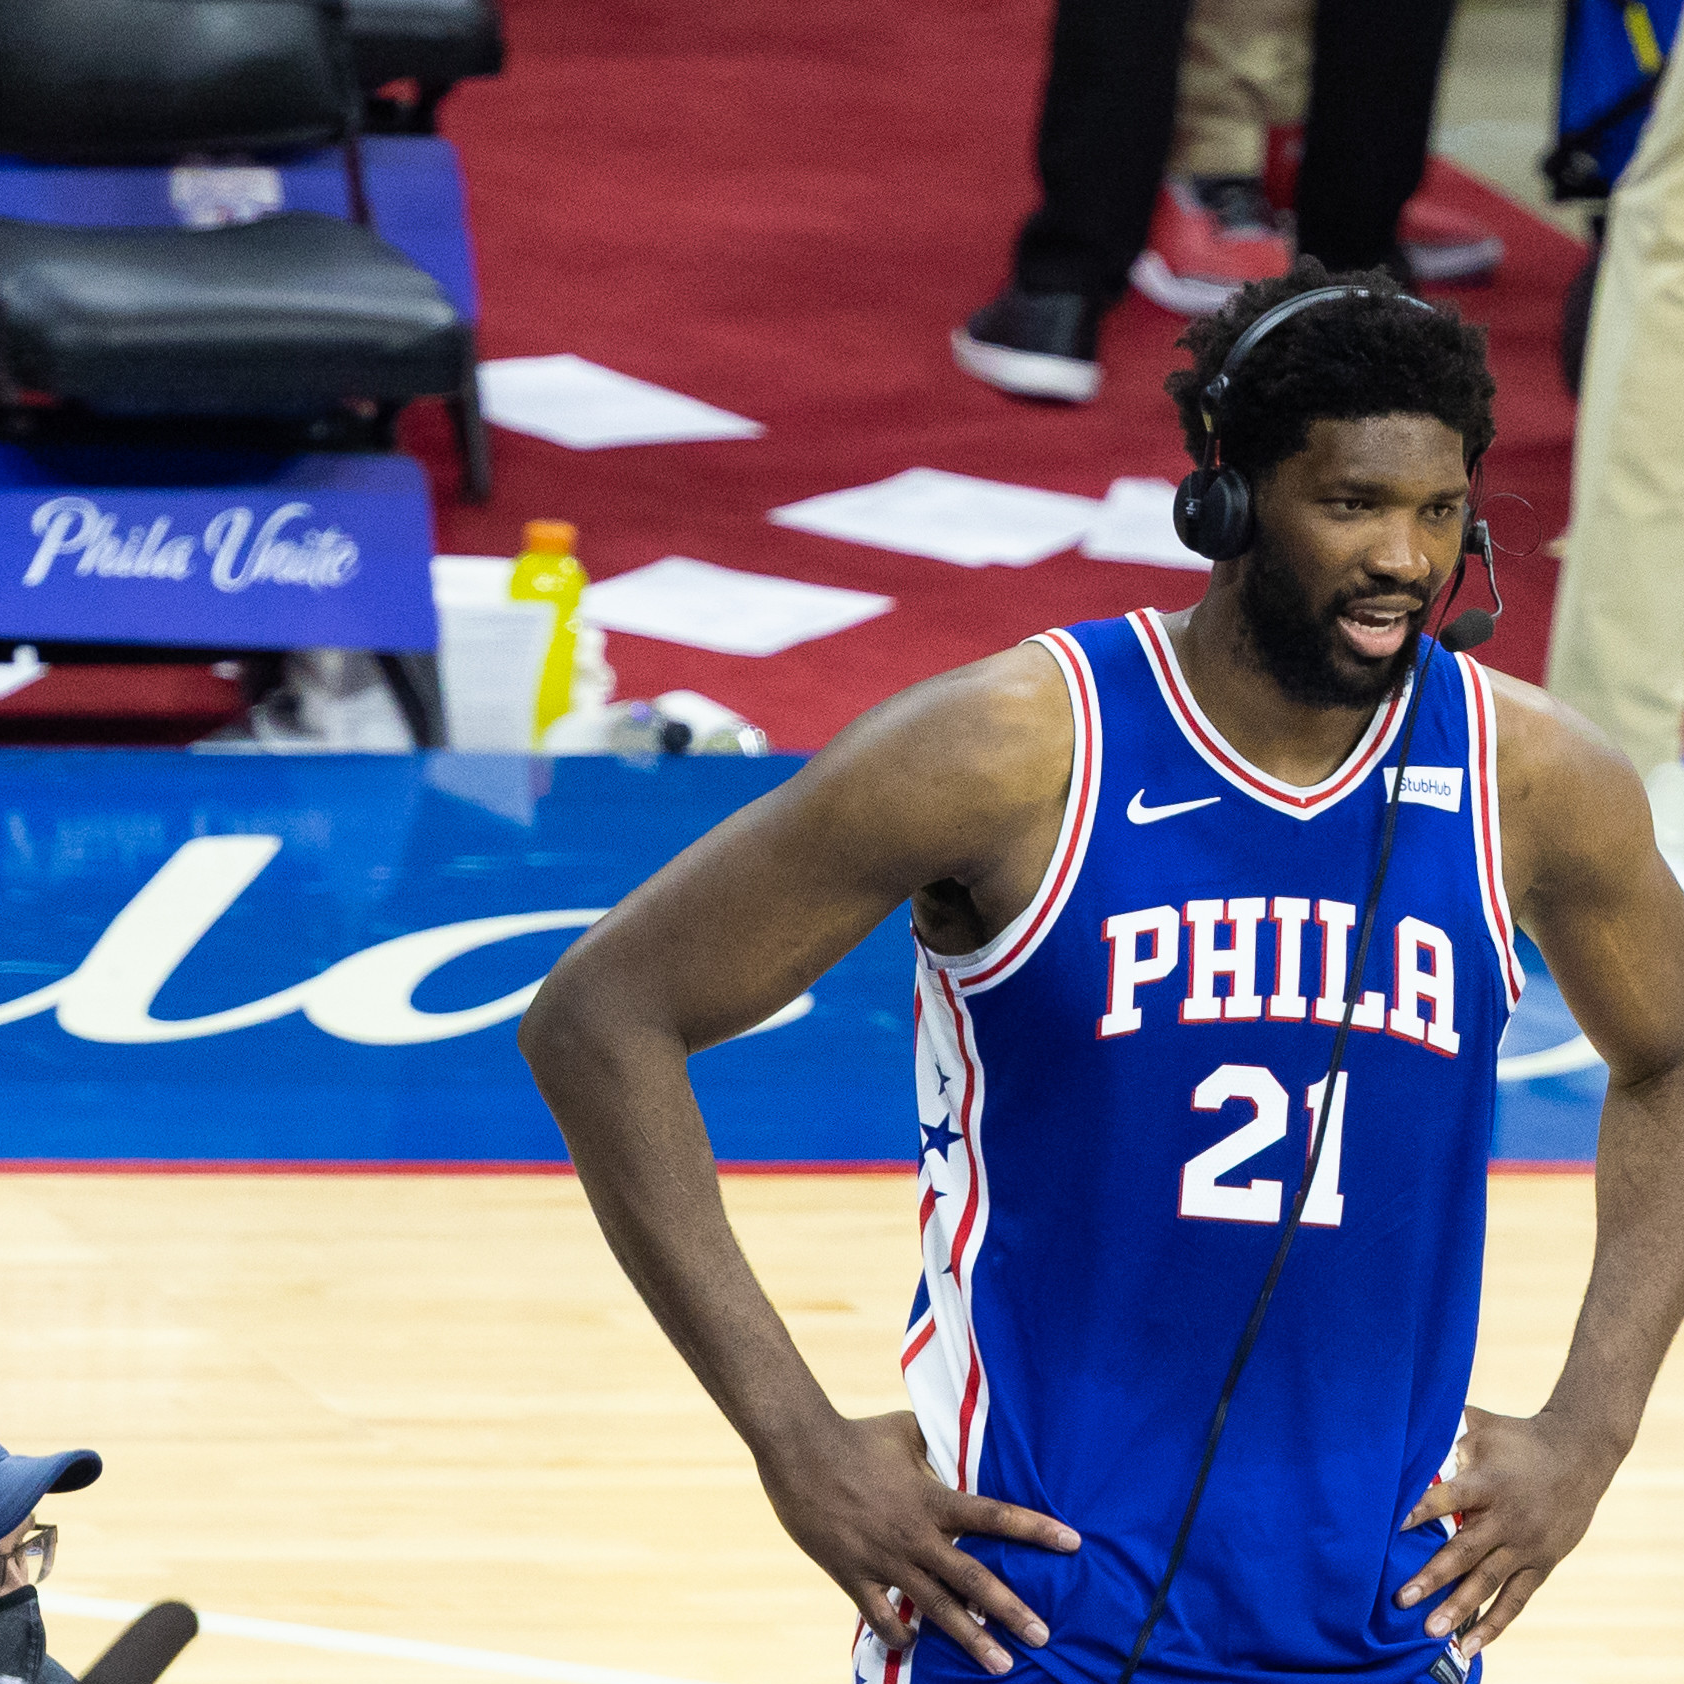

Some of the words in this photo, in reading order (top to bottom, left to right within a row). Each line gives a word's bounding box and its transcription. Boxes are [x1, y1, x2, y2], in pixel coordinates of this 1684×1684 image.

[21, 496, 195, 585] Phila
[202, 500, 359, 592] Unite
[1399, 777, 1452, 797] StubHub
[1096, 895, 1461, 1059] PHILA
[1177, 1063, 1349, 1228] 21
